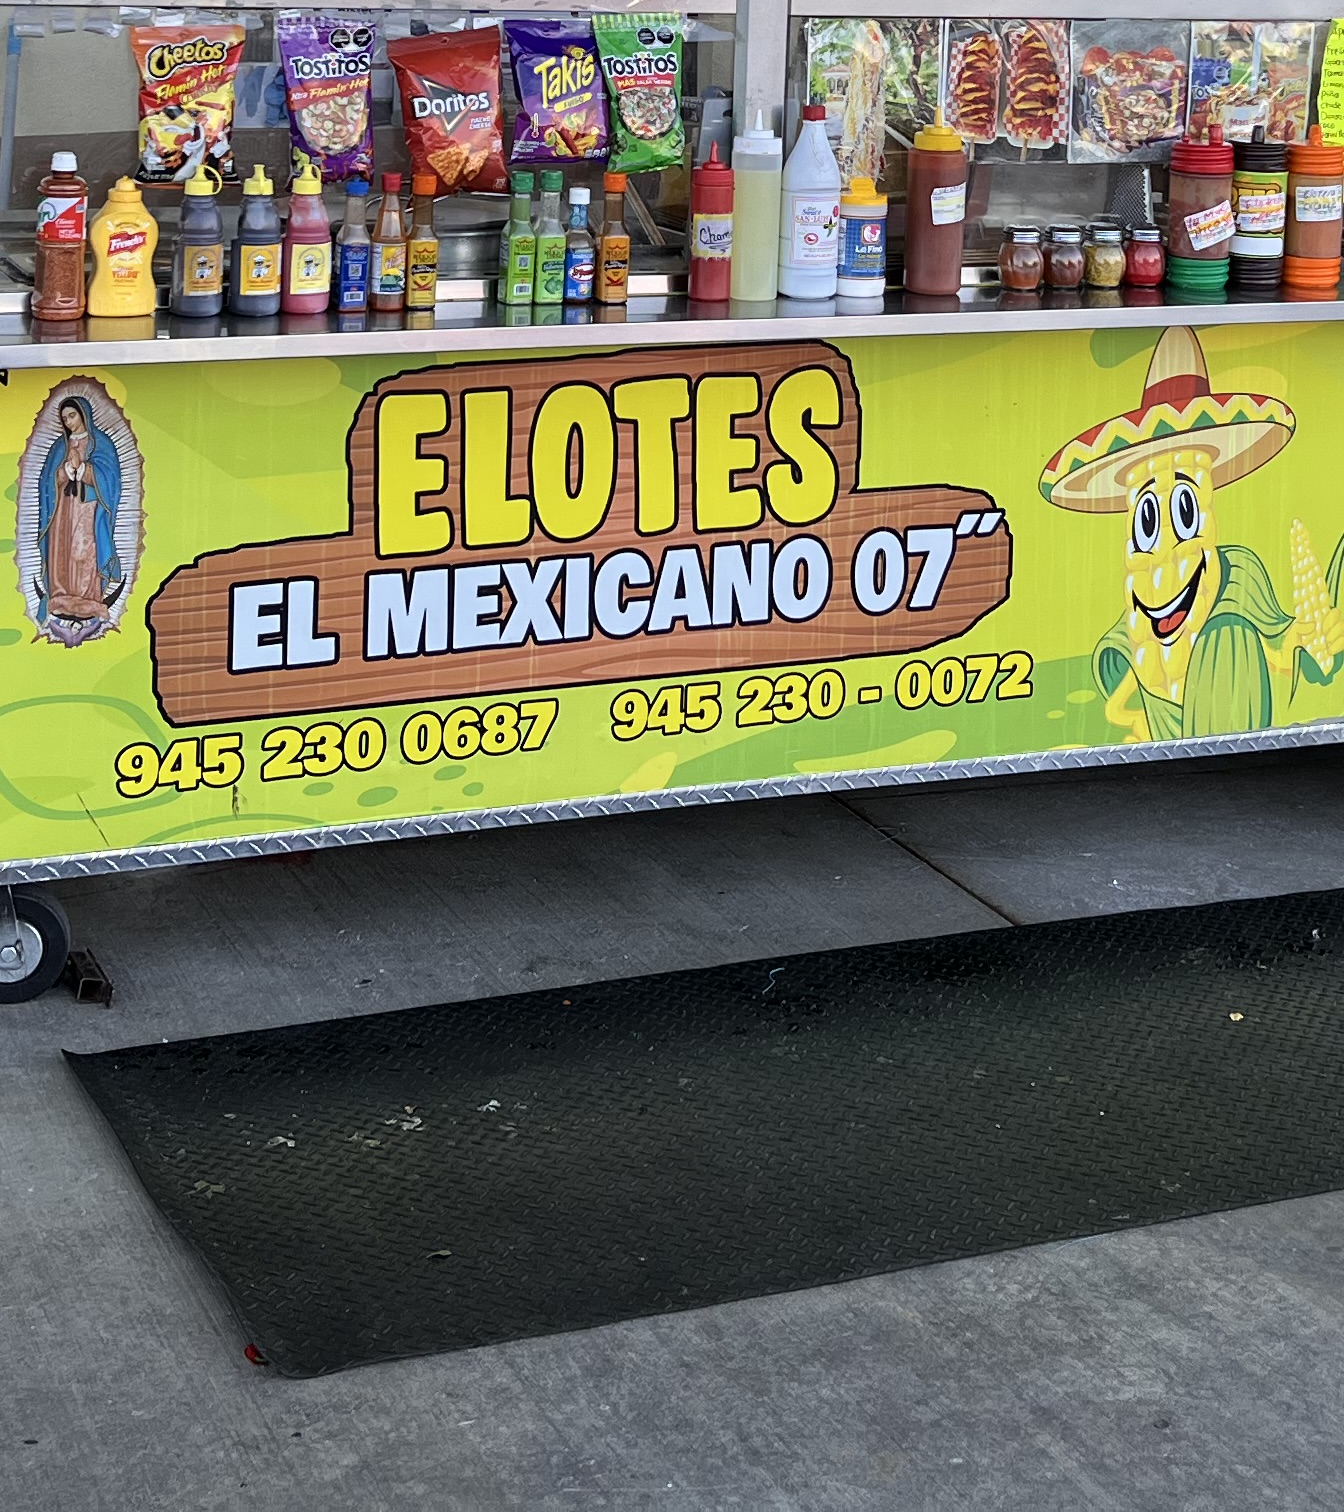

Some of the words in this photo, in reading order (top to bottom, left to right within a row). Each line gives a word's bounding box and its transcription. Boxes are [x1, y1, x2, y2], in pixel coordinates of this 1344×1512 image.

[145, 36, 227, 80] Cheetos
[201, 65, 227, 82] Hot
[534, 53, 596, 109] Takis
[413, 92, 490, 118] Doritos
[376, 369, 841, 558] ELOTES
[229, 578, 337, 675] EL
[364, 529, 832, 664] MEXICANO
[611, 686, 724, 743] 945
[735, 670, 845, 728] 230
[894, 652, 1034, 714] 0072
[115, 734, 244, 799] 945
[260, 716, 385, 782] 230
[402, 700, 559, 768] 0687
